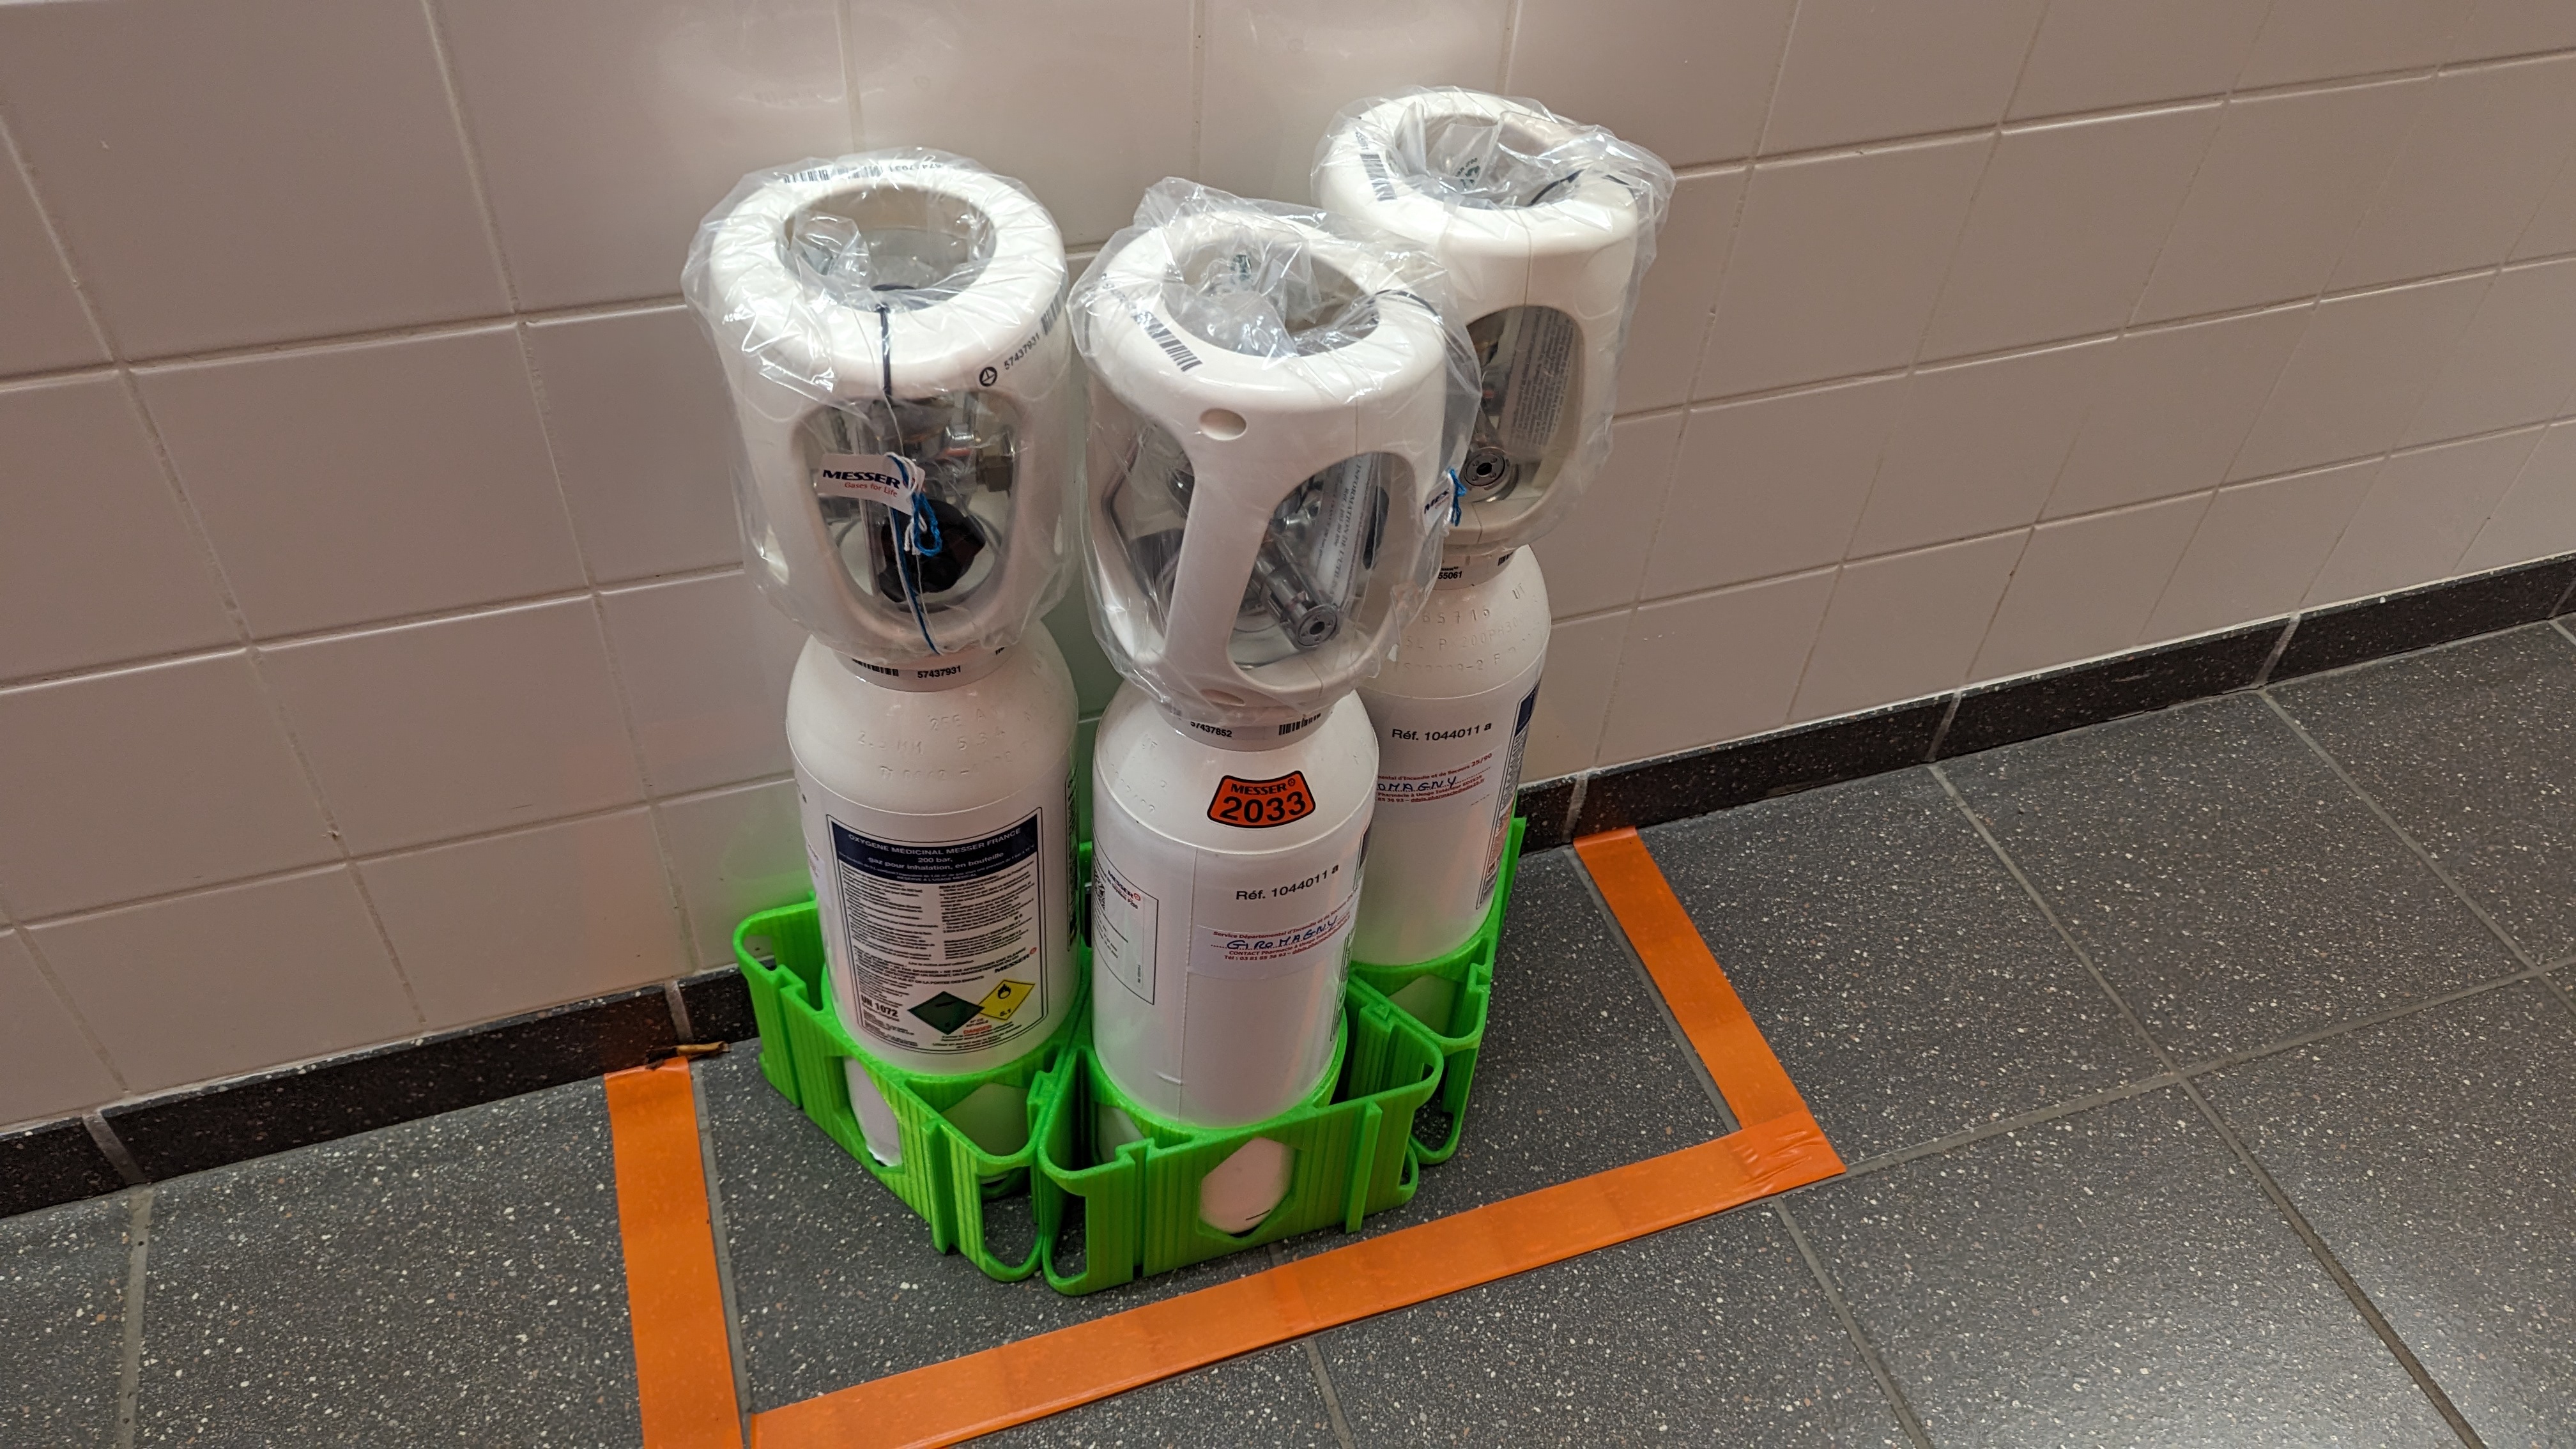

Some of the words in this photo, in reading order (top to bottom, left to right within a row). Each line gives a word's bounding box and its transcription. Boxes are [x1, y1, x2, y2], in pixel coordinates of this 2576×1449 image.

[889, 164, 942, 172] 5747931
[1004, 332, 1040, 370] 57437931
[823, 469, 901, 489] MESSER
[870, 482, 881, 491] for
[884, 487, 898, 497] Life
[917, 664, 962, 679] 57437931
[1190, 720, 1232, 738] 57437852
[1392, 728, 1420, 741] Réf.
[1424, 724, 1480, 741] 1044011
[1483, 722, 1492, 731] a
[1447, 765, 1470, 775] Secours
[1471, 753, 1492, 767] 25/90
[1230, 783, 1287, 795] MESSER
[1377, 776, 1457, 792] OMAGNY
[1219, 791, 1307, 824] 2033
[946, 842, 985, 855] MESSER
[986, 827, 1022, 847] FRANCE
[868, 857, 883, 865] gaz
[885, 862, 905, 870] pour
[968, 852, 1004, 867] bouteille
[1236, 890, 1266, 901] Réf.
[1271, 870, 1328, 898] 1044011
[1331, 864, 1339, 874] a
[1239, 931, 1287, 940] Départemental
[1261, 946, 1294, 955] Pharmacie
[861, 994, 873, 1007] UN
[875, 1003, 899, 1018] 1072
